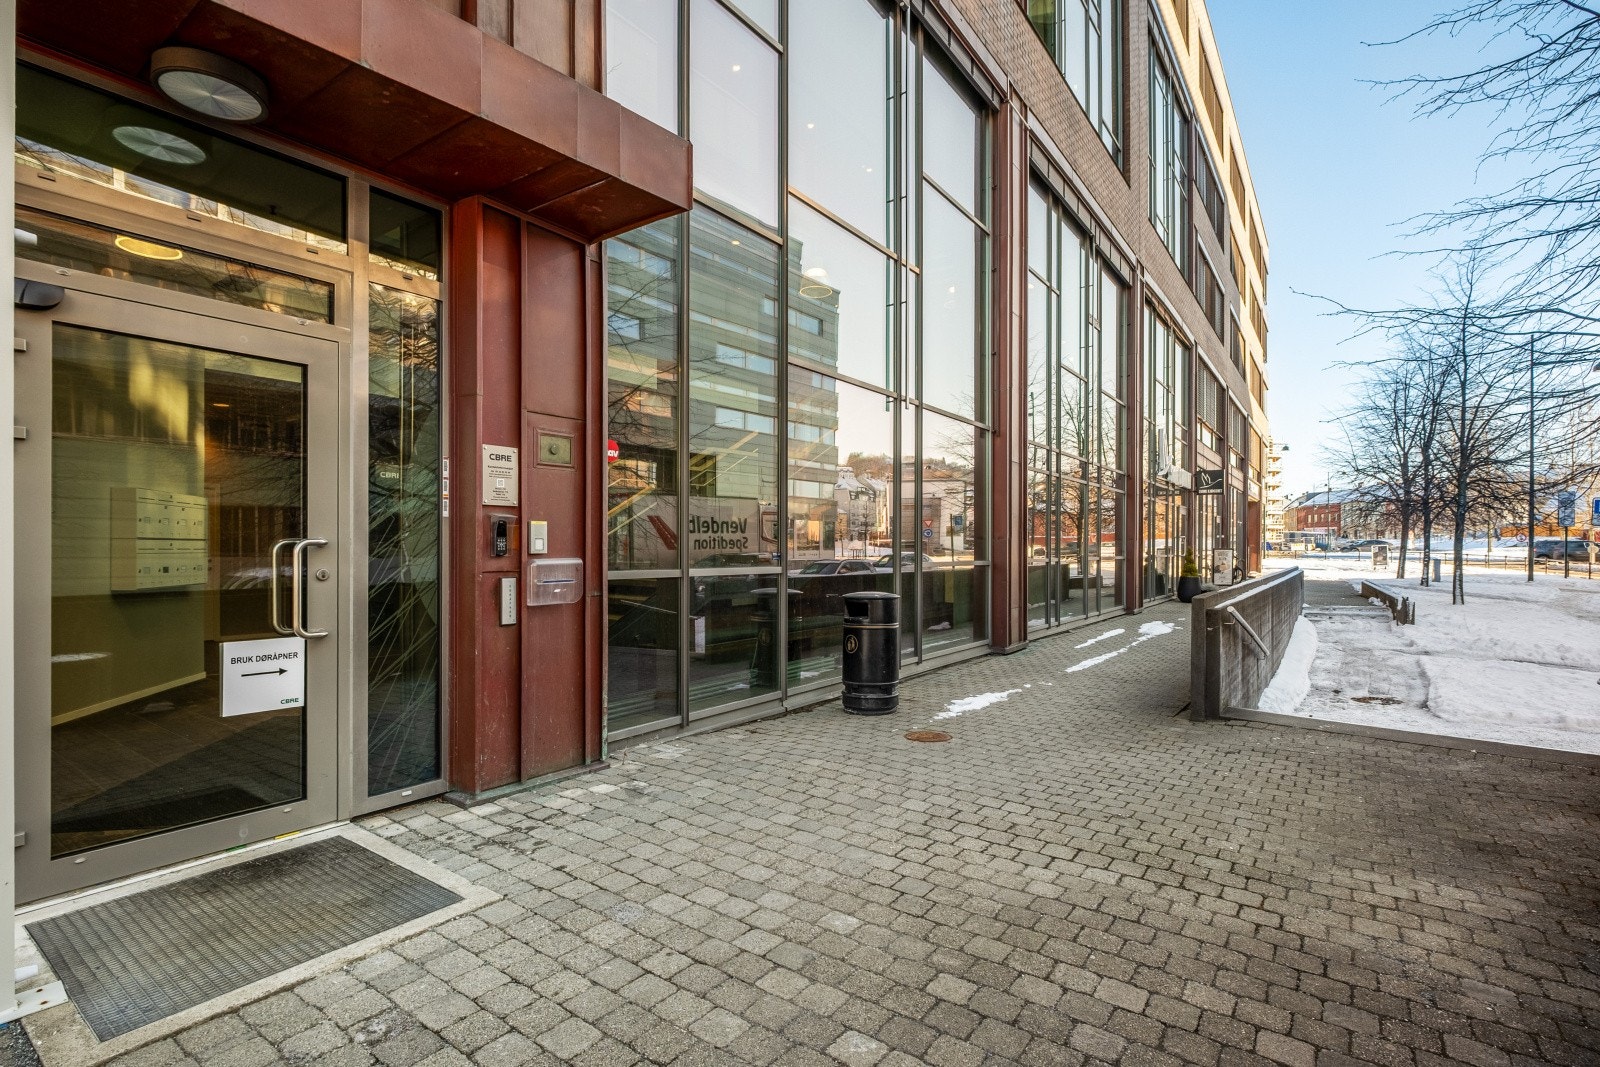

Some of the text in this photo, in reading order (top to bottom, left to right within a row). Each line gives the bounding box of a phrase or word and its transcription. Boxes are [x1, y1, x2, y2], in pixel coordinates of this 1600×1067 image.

[489, 453, 512, 462] CBRE
[230, 651, 298, 665] BRUK DØRÅPNER
